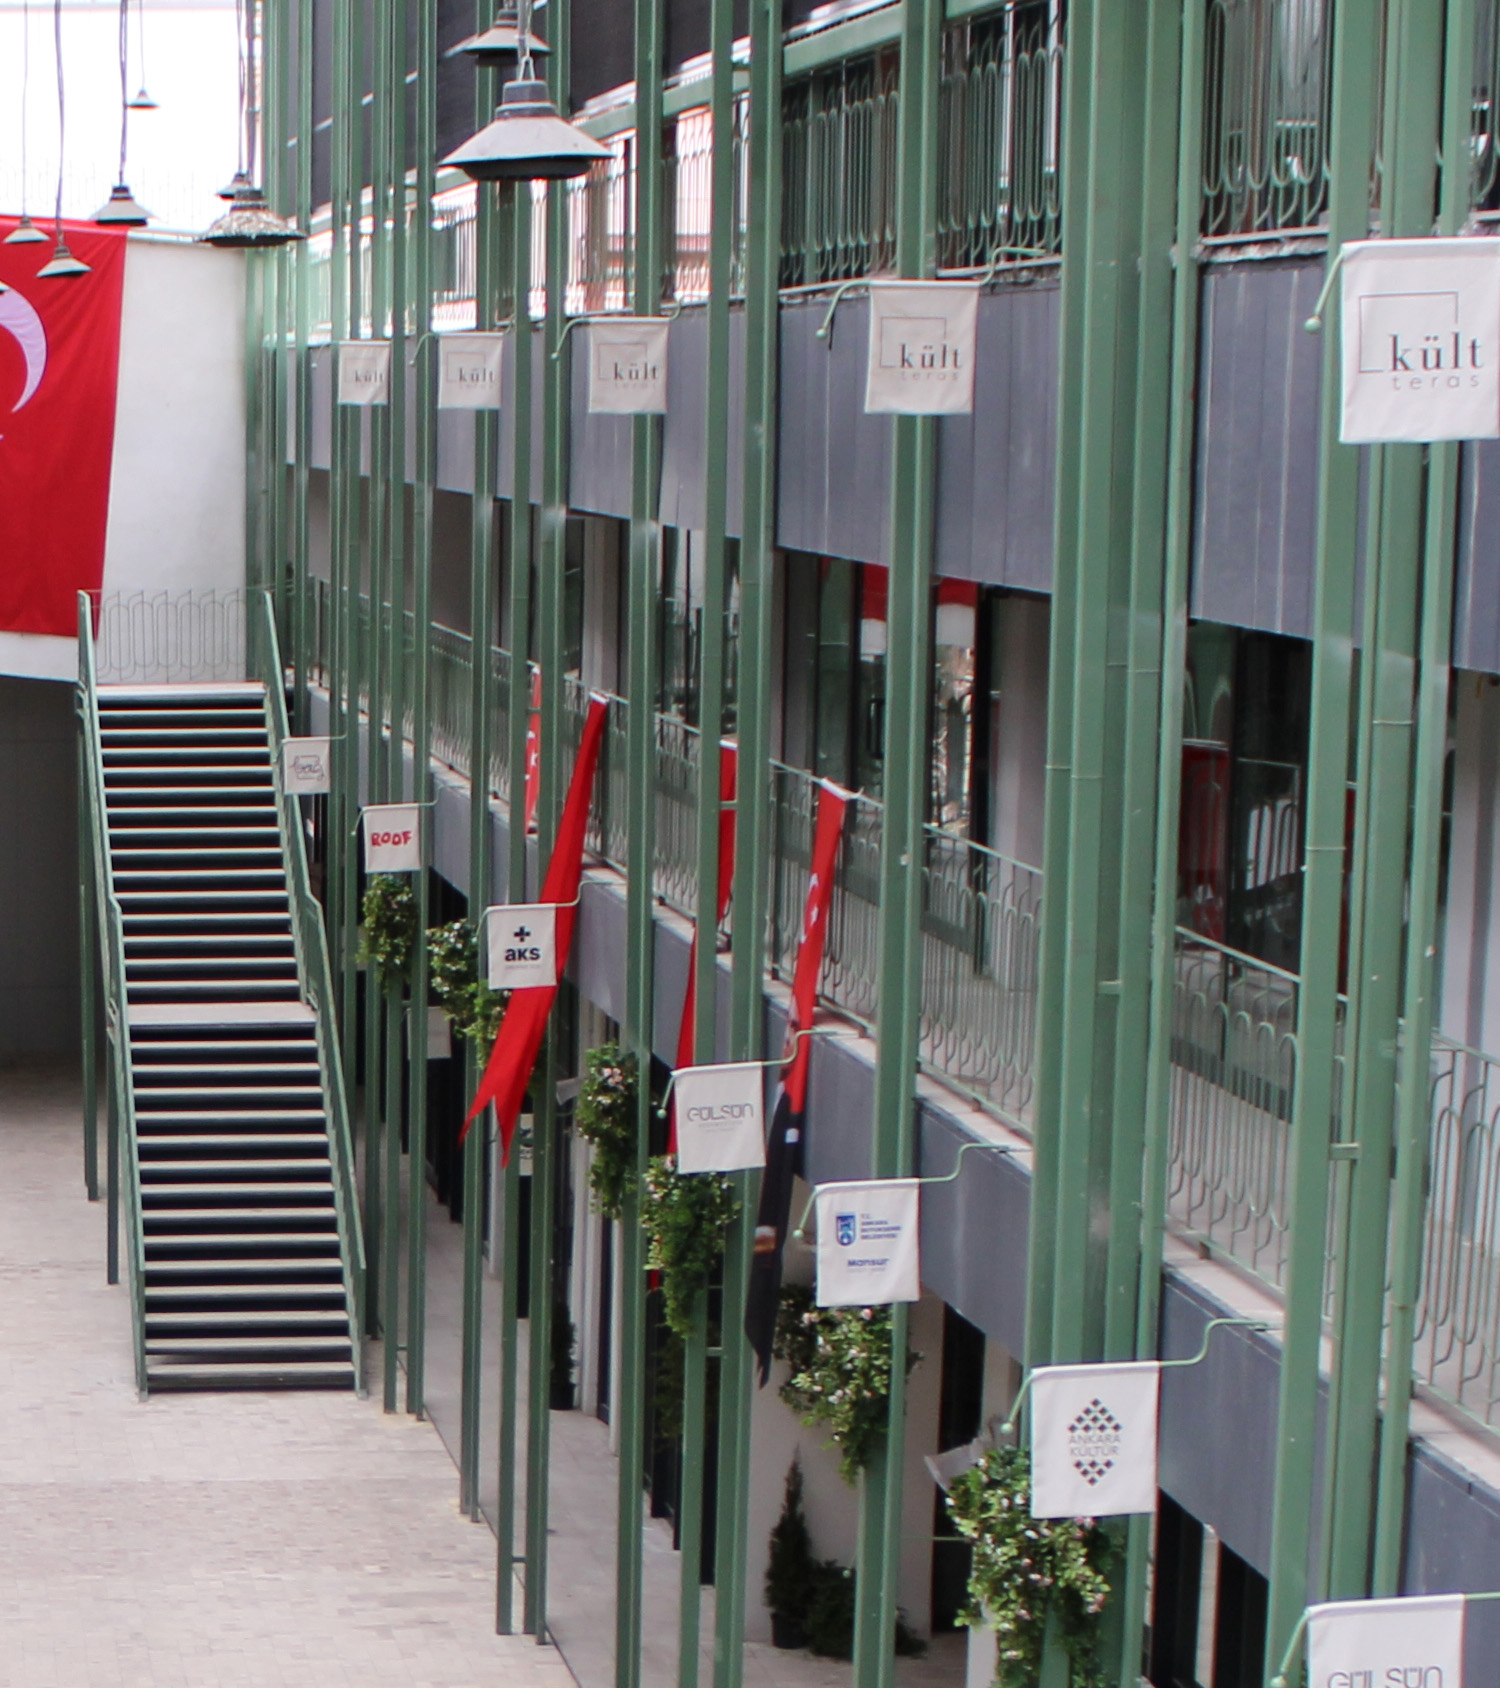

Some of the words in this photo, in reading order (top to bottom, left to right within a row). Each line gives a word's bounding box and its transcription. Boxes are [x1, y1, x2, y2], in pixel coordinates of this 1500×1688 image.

[901, 342, 963, 369] kült
[1389, 331, 1485, 372] kült
[459, 366, 496, 383] kült
[613, 361, 659, 381] kült
[1393, 370, 1481, 390] teras
[371, 830, 412, 847] ROOF
[1068, 1432, 1121, 1445] ANKARA
[1070, 1443, 1120, 1457] KÜLTÜR
